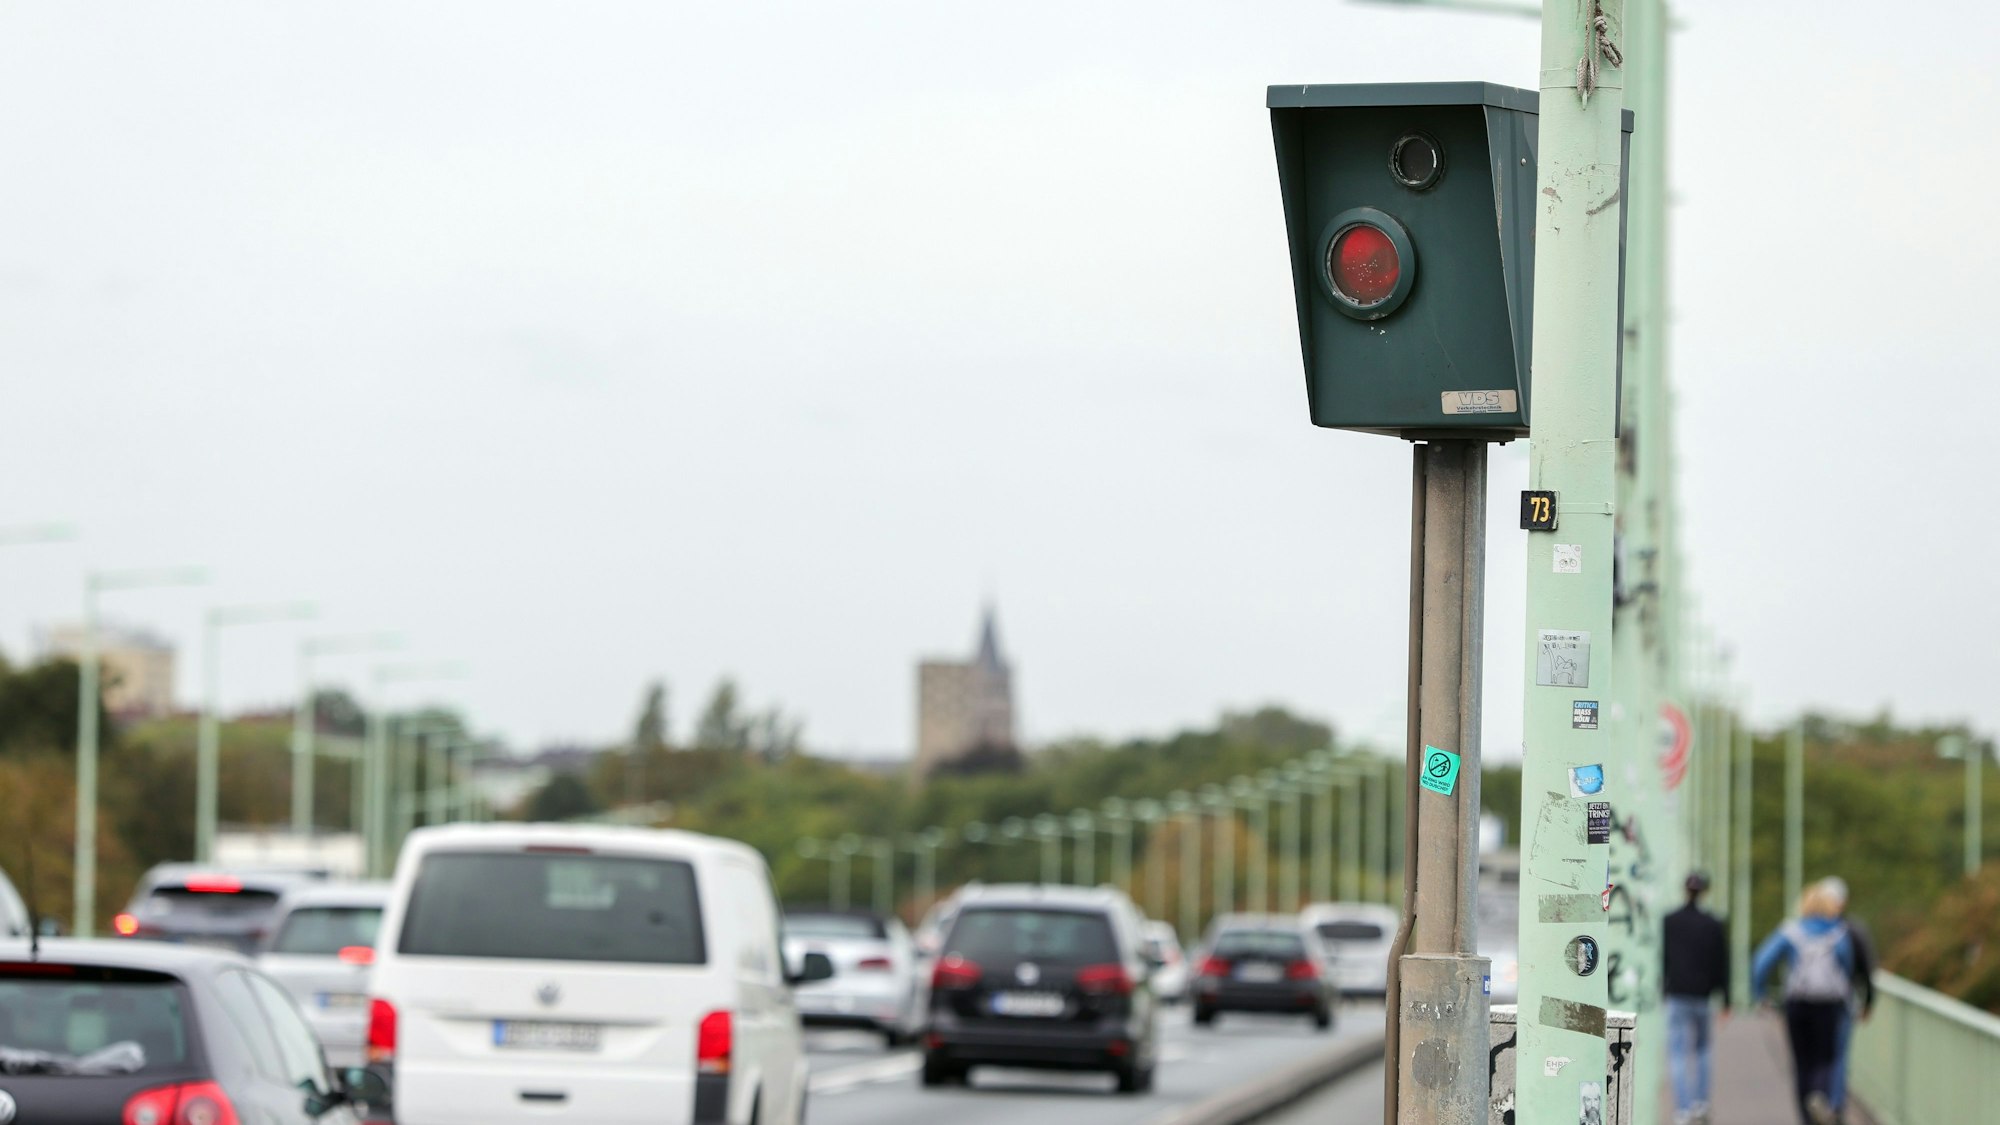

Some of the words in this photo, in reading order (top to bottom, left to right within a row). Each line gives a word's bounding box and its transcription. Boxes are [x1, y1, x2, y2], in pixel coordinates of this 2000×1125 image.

[1458, 391, 1499, 405] VDS
[1530, 497, 1550, 522] 73
[1574, 701, 1598, 709] CRITICAL
[1573, 714, 1590, 723] KÖLN
